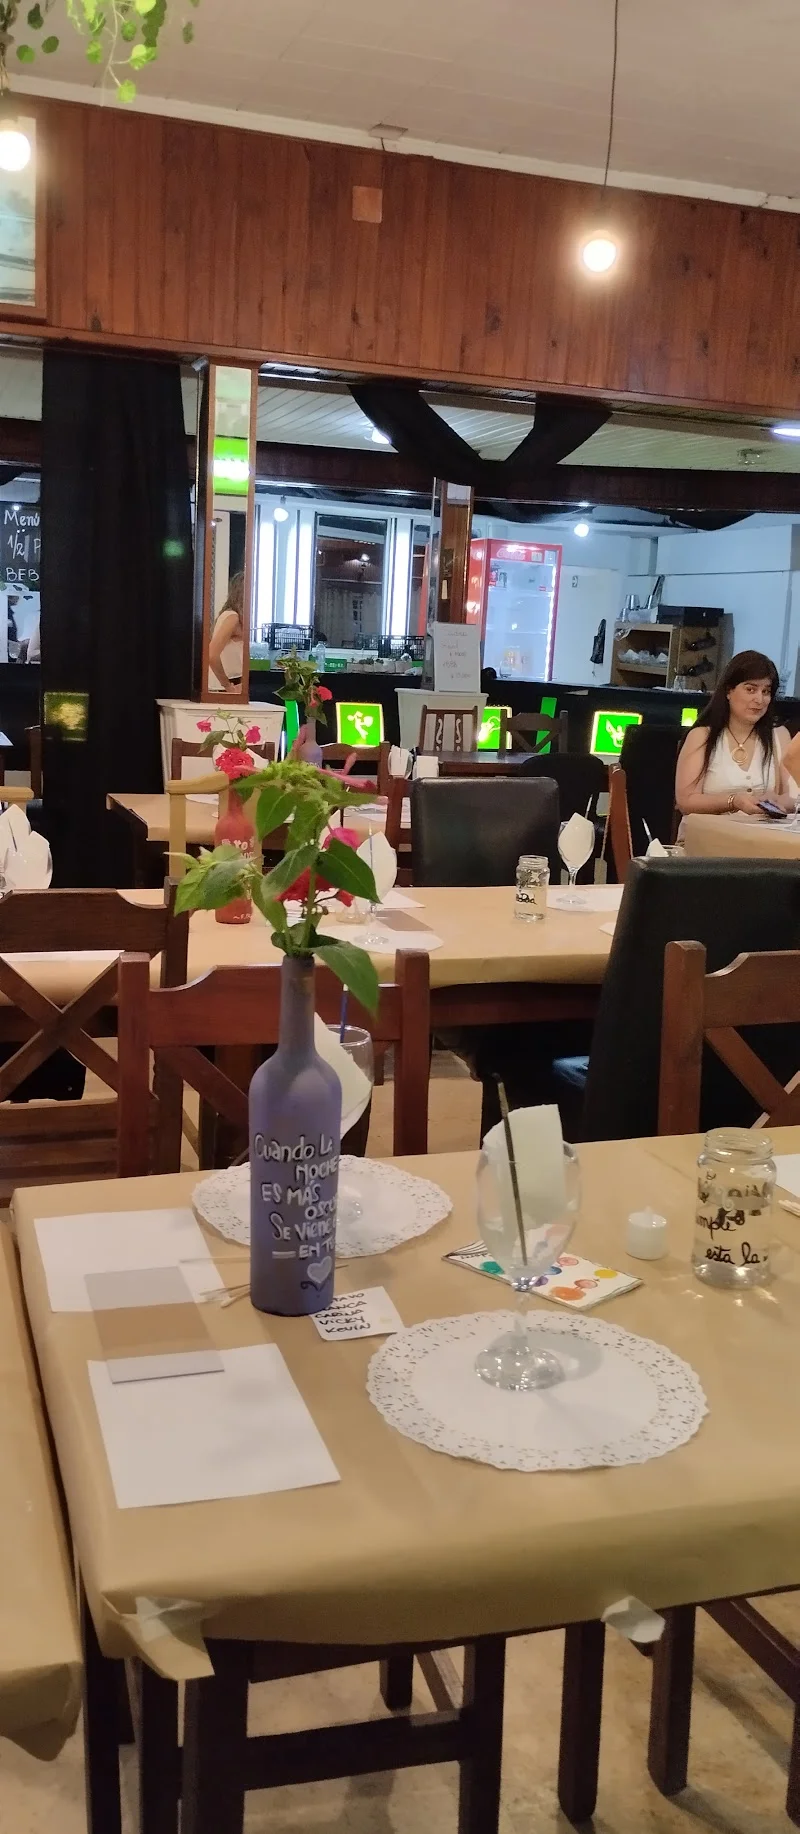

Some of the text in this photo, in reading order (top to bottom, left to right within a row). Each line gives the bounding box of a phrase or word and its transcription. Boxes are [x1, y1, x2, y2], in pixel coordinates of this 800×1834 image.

[254, 1133, 315, 1163] Cuando
[295, 1156, 339, 1186] NOCHE
[261, 1180, 321, 1206] ES MÁS
